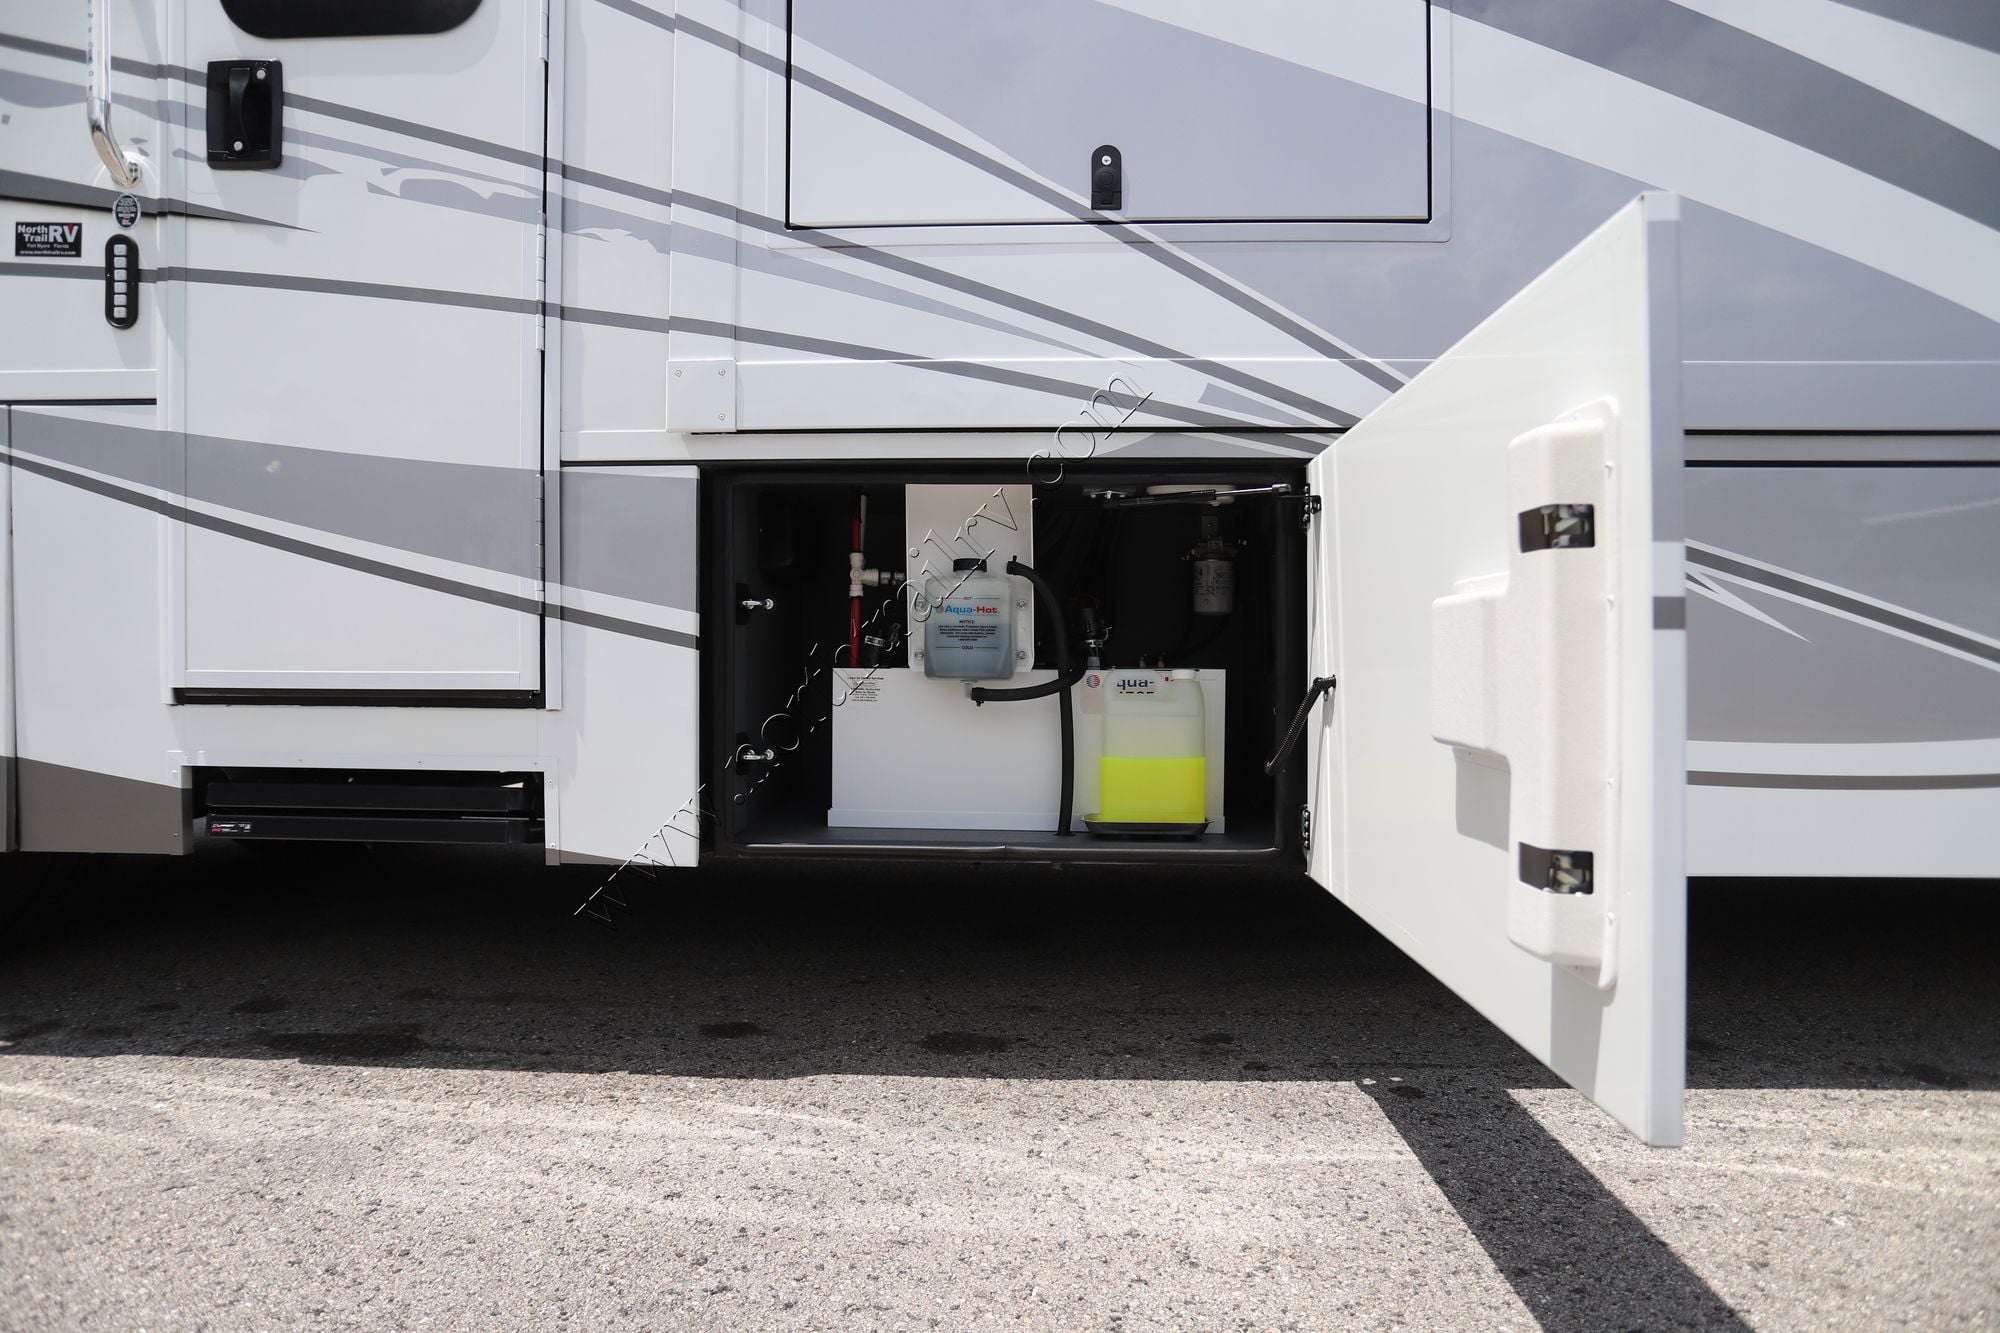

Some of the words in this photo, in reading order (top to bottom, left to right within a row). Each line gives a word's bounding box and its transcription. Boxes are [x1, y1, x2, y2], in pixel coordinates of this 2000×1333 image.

[17, 224, 48, 234] North
[49, 224, 79, 243] RV
[24, 233, 48, 242] Trail
[944, 605, 998, 615] Aqua-Hot
